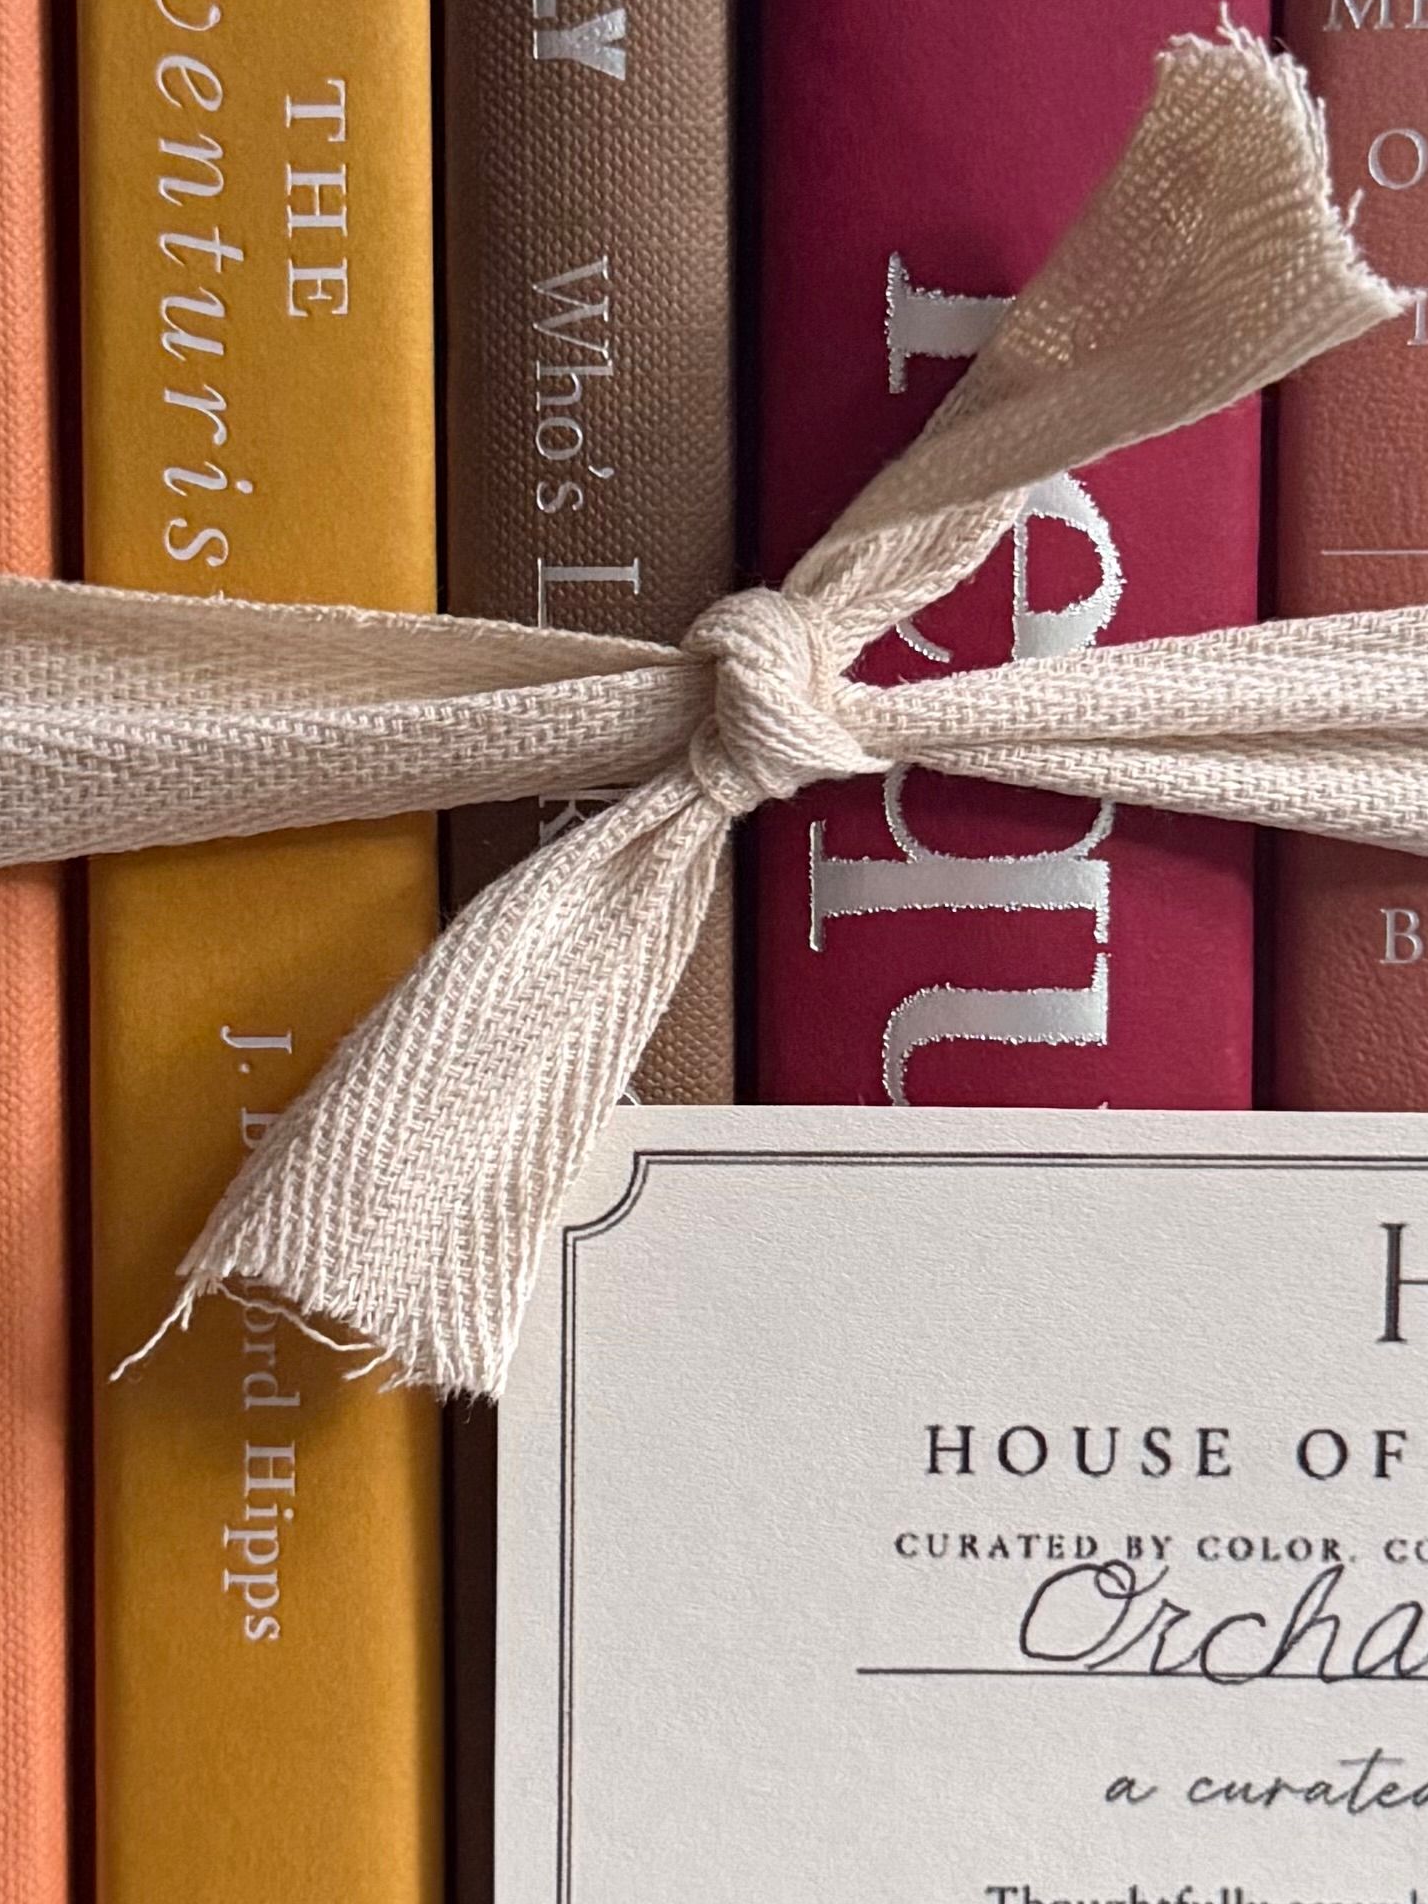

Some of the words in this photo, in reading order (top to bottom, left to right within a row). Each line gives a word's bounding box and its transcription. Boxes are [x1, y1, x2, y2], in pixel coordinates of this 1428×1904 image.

[286, 79, 350, 318] THE
[533, 254, 615, 514] Who's
[220, 1025, 293, 1074] J.
[925, 1424, 1234, 1480] HOUSE
[1296, 1427, 1409, 1482] OF
[222, 1440, 296, 1642] Hipps
[894, 1531, 1099, 1560] CURATED
[1125, 1533, 1173, 1561] BY
[1104, 1776, 1158, 1805] a
